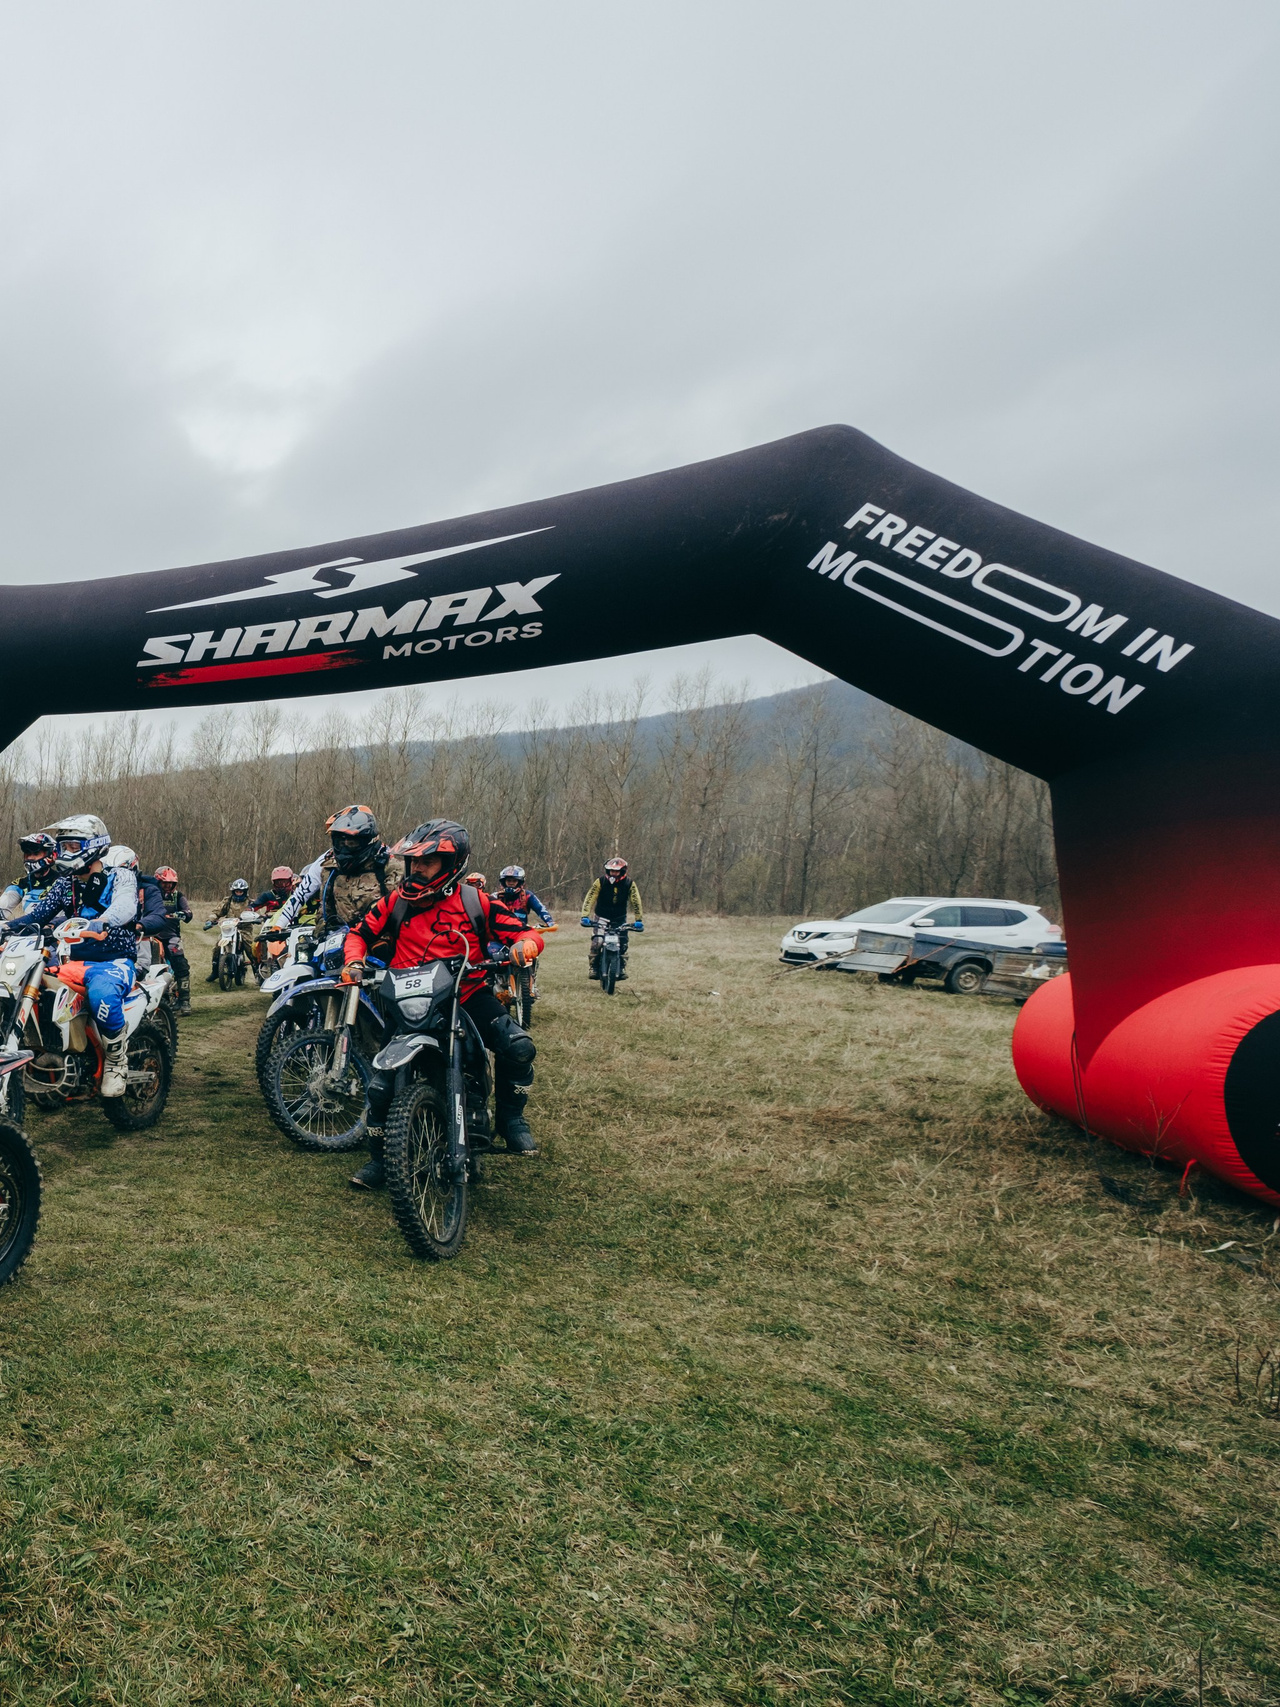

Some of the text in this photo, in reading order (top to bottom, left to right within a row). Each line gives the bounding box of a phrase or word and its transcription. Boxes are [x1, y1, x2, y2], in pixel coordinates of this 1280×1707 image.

[136, 573, 562, 668] SHARMAX
[843, 502, 1195, 673] FREEDOM IN
[382, 621, 544, 660] MOTORS
[806, 540, 1146, 715] MOTION
[97, 999, 111, 1023] FOX
[405, 979, 422, 990] 58
